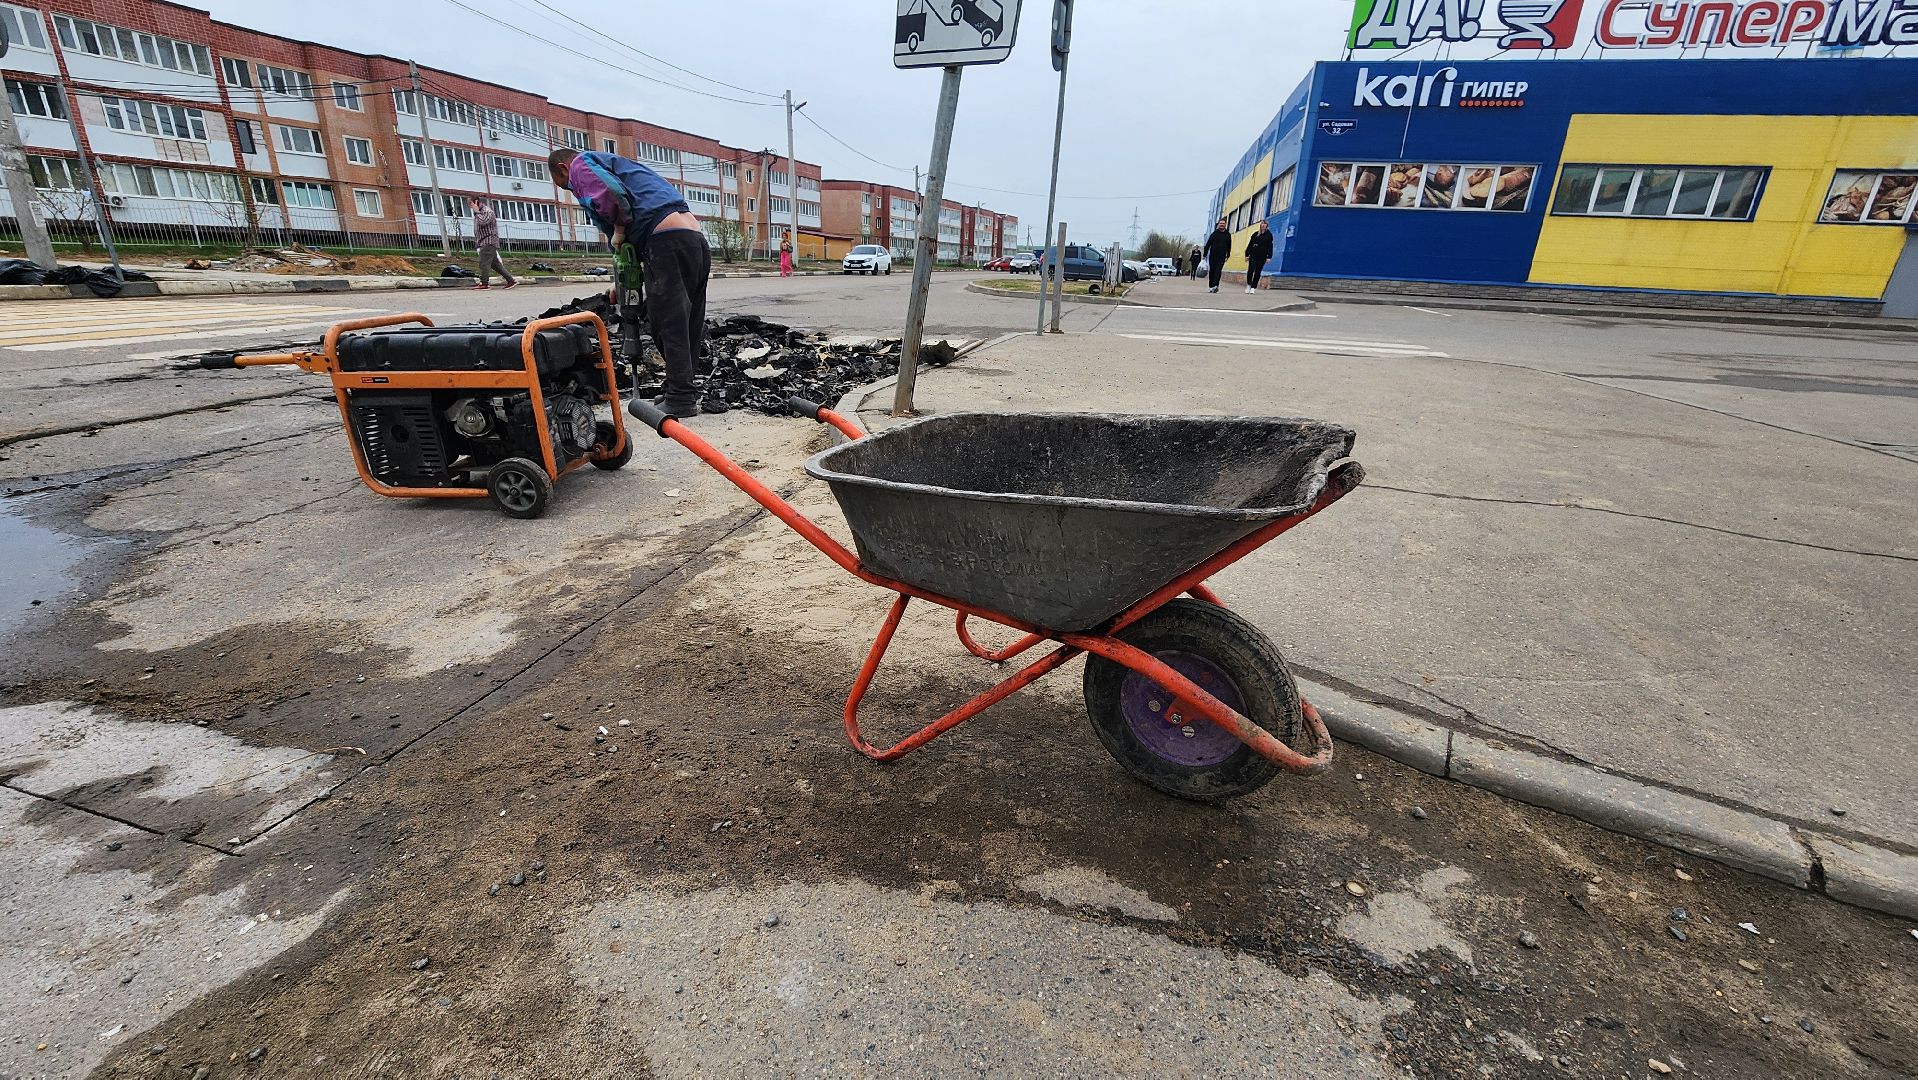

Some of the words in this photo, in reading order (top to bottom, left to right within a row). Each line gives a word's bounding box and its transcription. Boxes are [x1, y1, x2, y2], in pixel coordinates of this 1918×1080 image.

[1355, 0, 1482, 47] ДА!
[1353, 67, 1458, 107] kari
[1460, 81, 1529, 98] ГИПЕР
